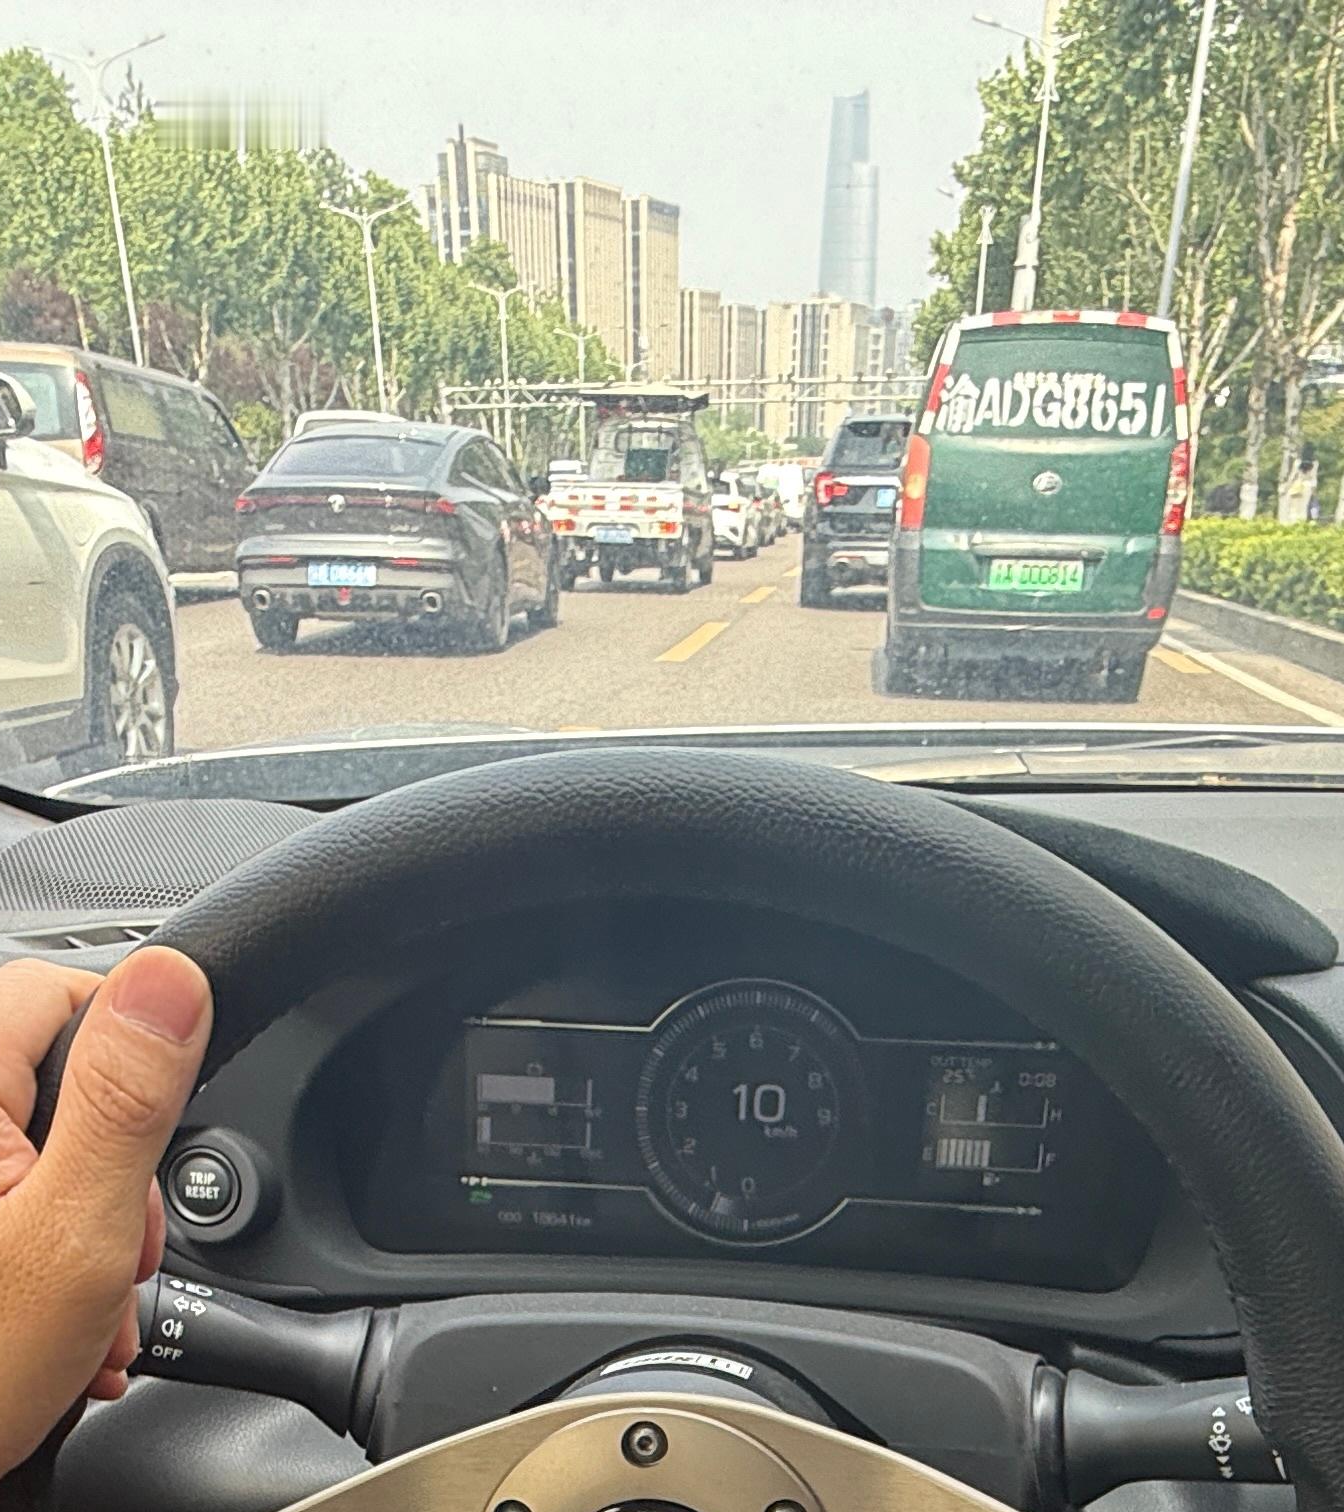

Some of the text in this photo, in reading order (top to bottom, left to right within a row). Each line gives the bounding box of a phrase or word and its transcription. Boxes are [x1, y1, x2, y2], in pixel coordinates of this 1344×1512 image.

[685, 1065, 699, 1082] 4
[732, 1083, 786, 1122] 10
[190, 1172, 216, 1185] TRIP
[185, 1185, 220, 1199] RESET
[152, 1345, 183, 1360] OFF
